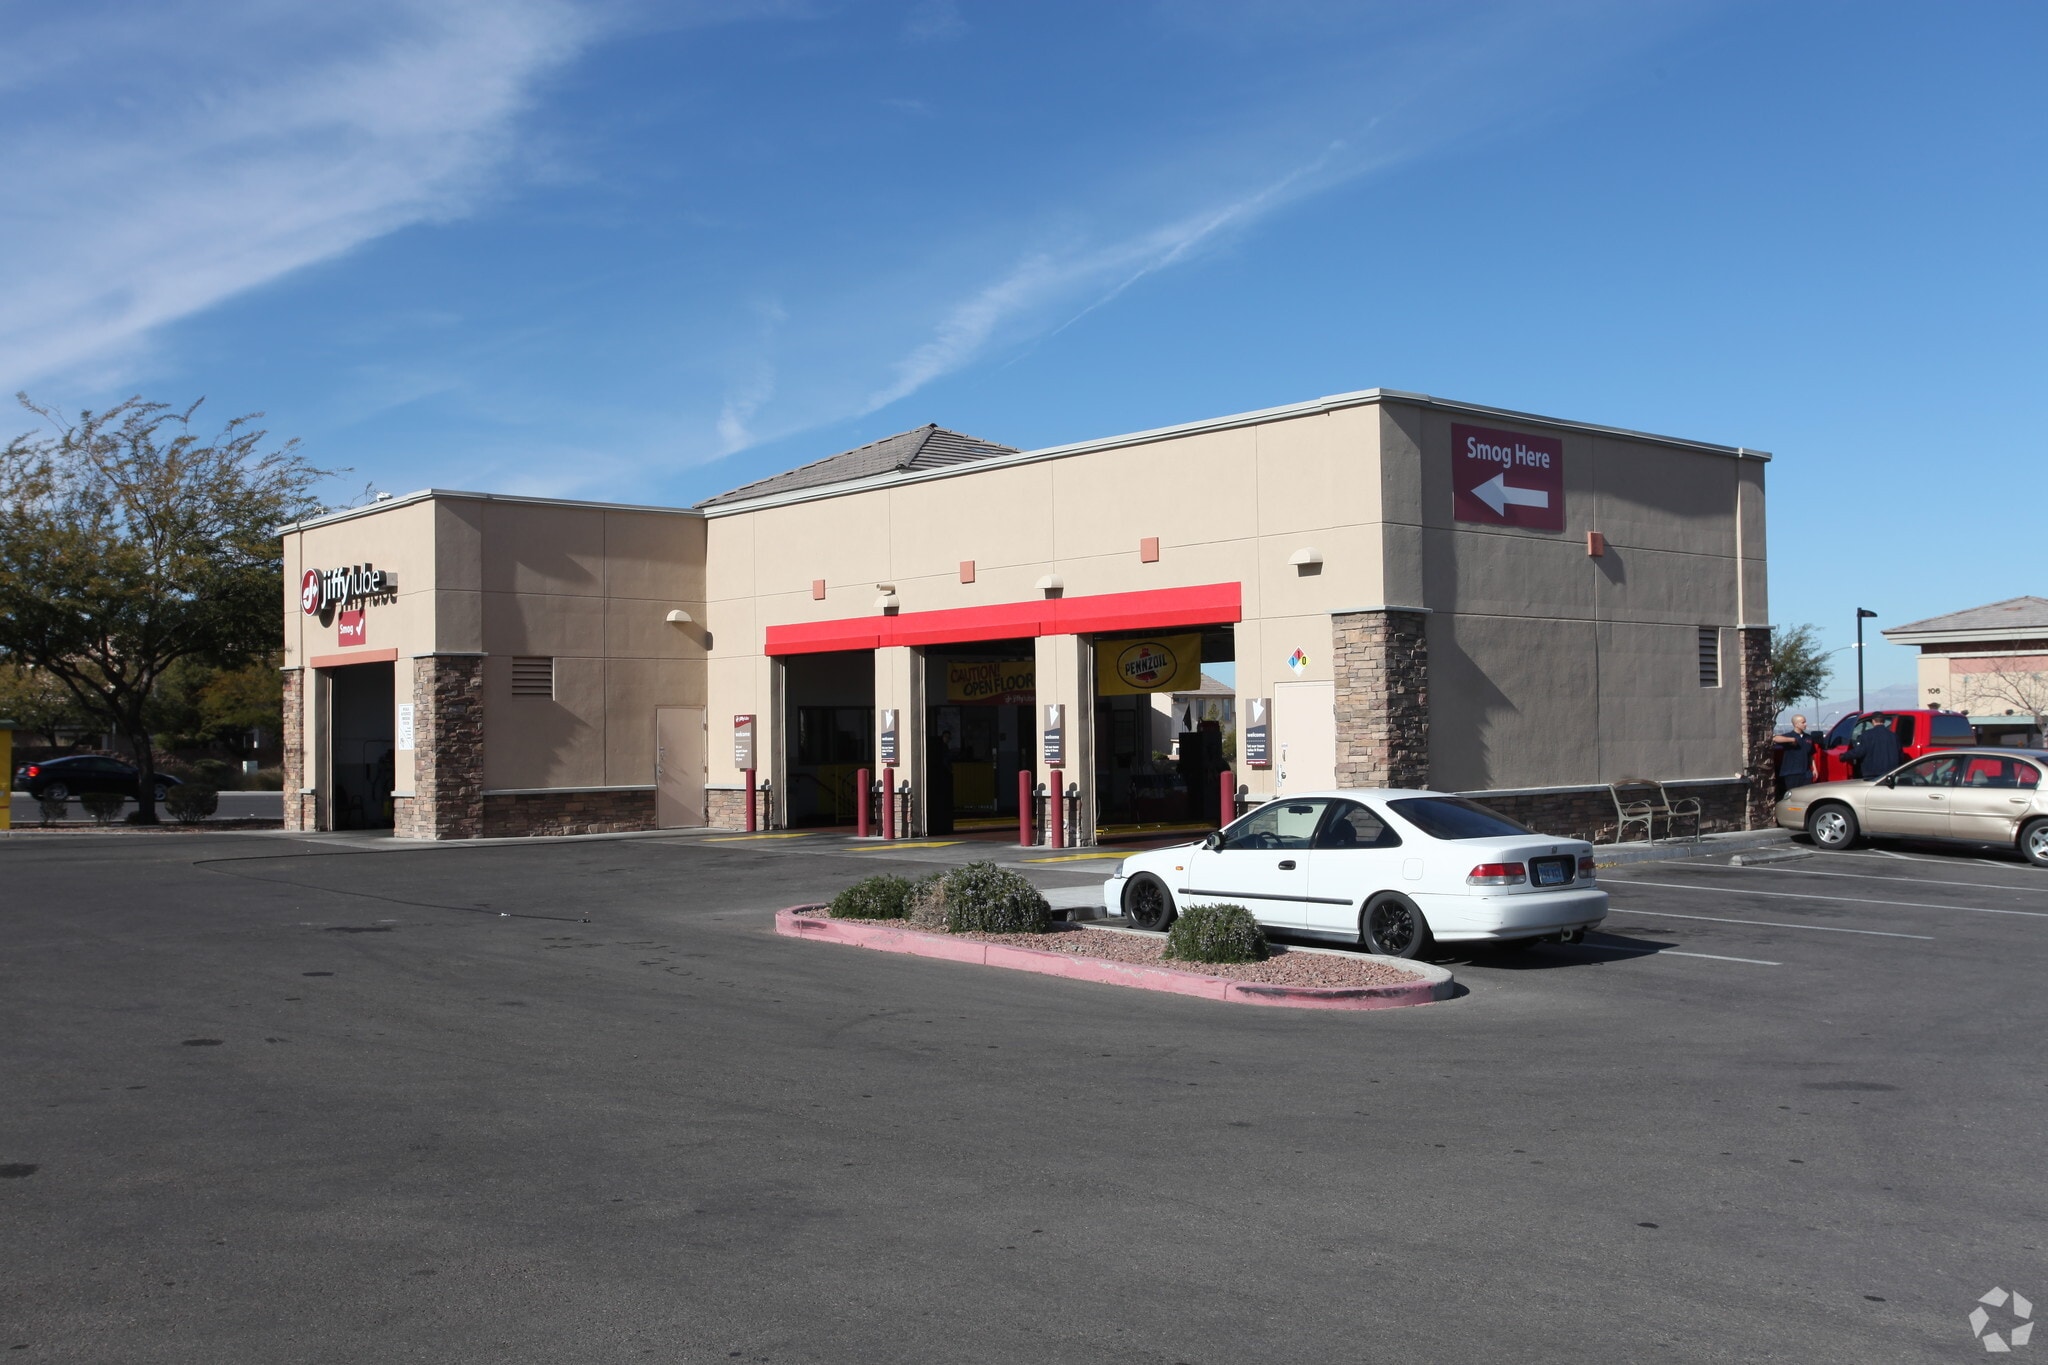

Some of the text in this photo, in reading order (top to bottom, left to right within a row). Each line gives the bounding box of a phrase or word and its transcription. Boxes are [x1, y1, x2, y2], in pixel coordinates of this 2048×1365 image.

[1467, 436, 1550, 468] Smog Here
[339, 624, 354, 636] Smog
[951, 664, 1000, 683] CAUTION!
[1125, 654, 1168, 676] PENNZOIL
[963, 672, 1034, 696] OPEN FLOOR
